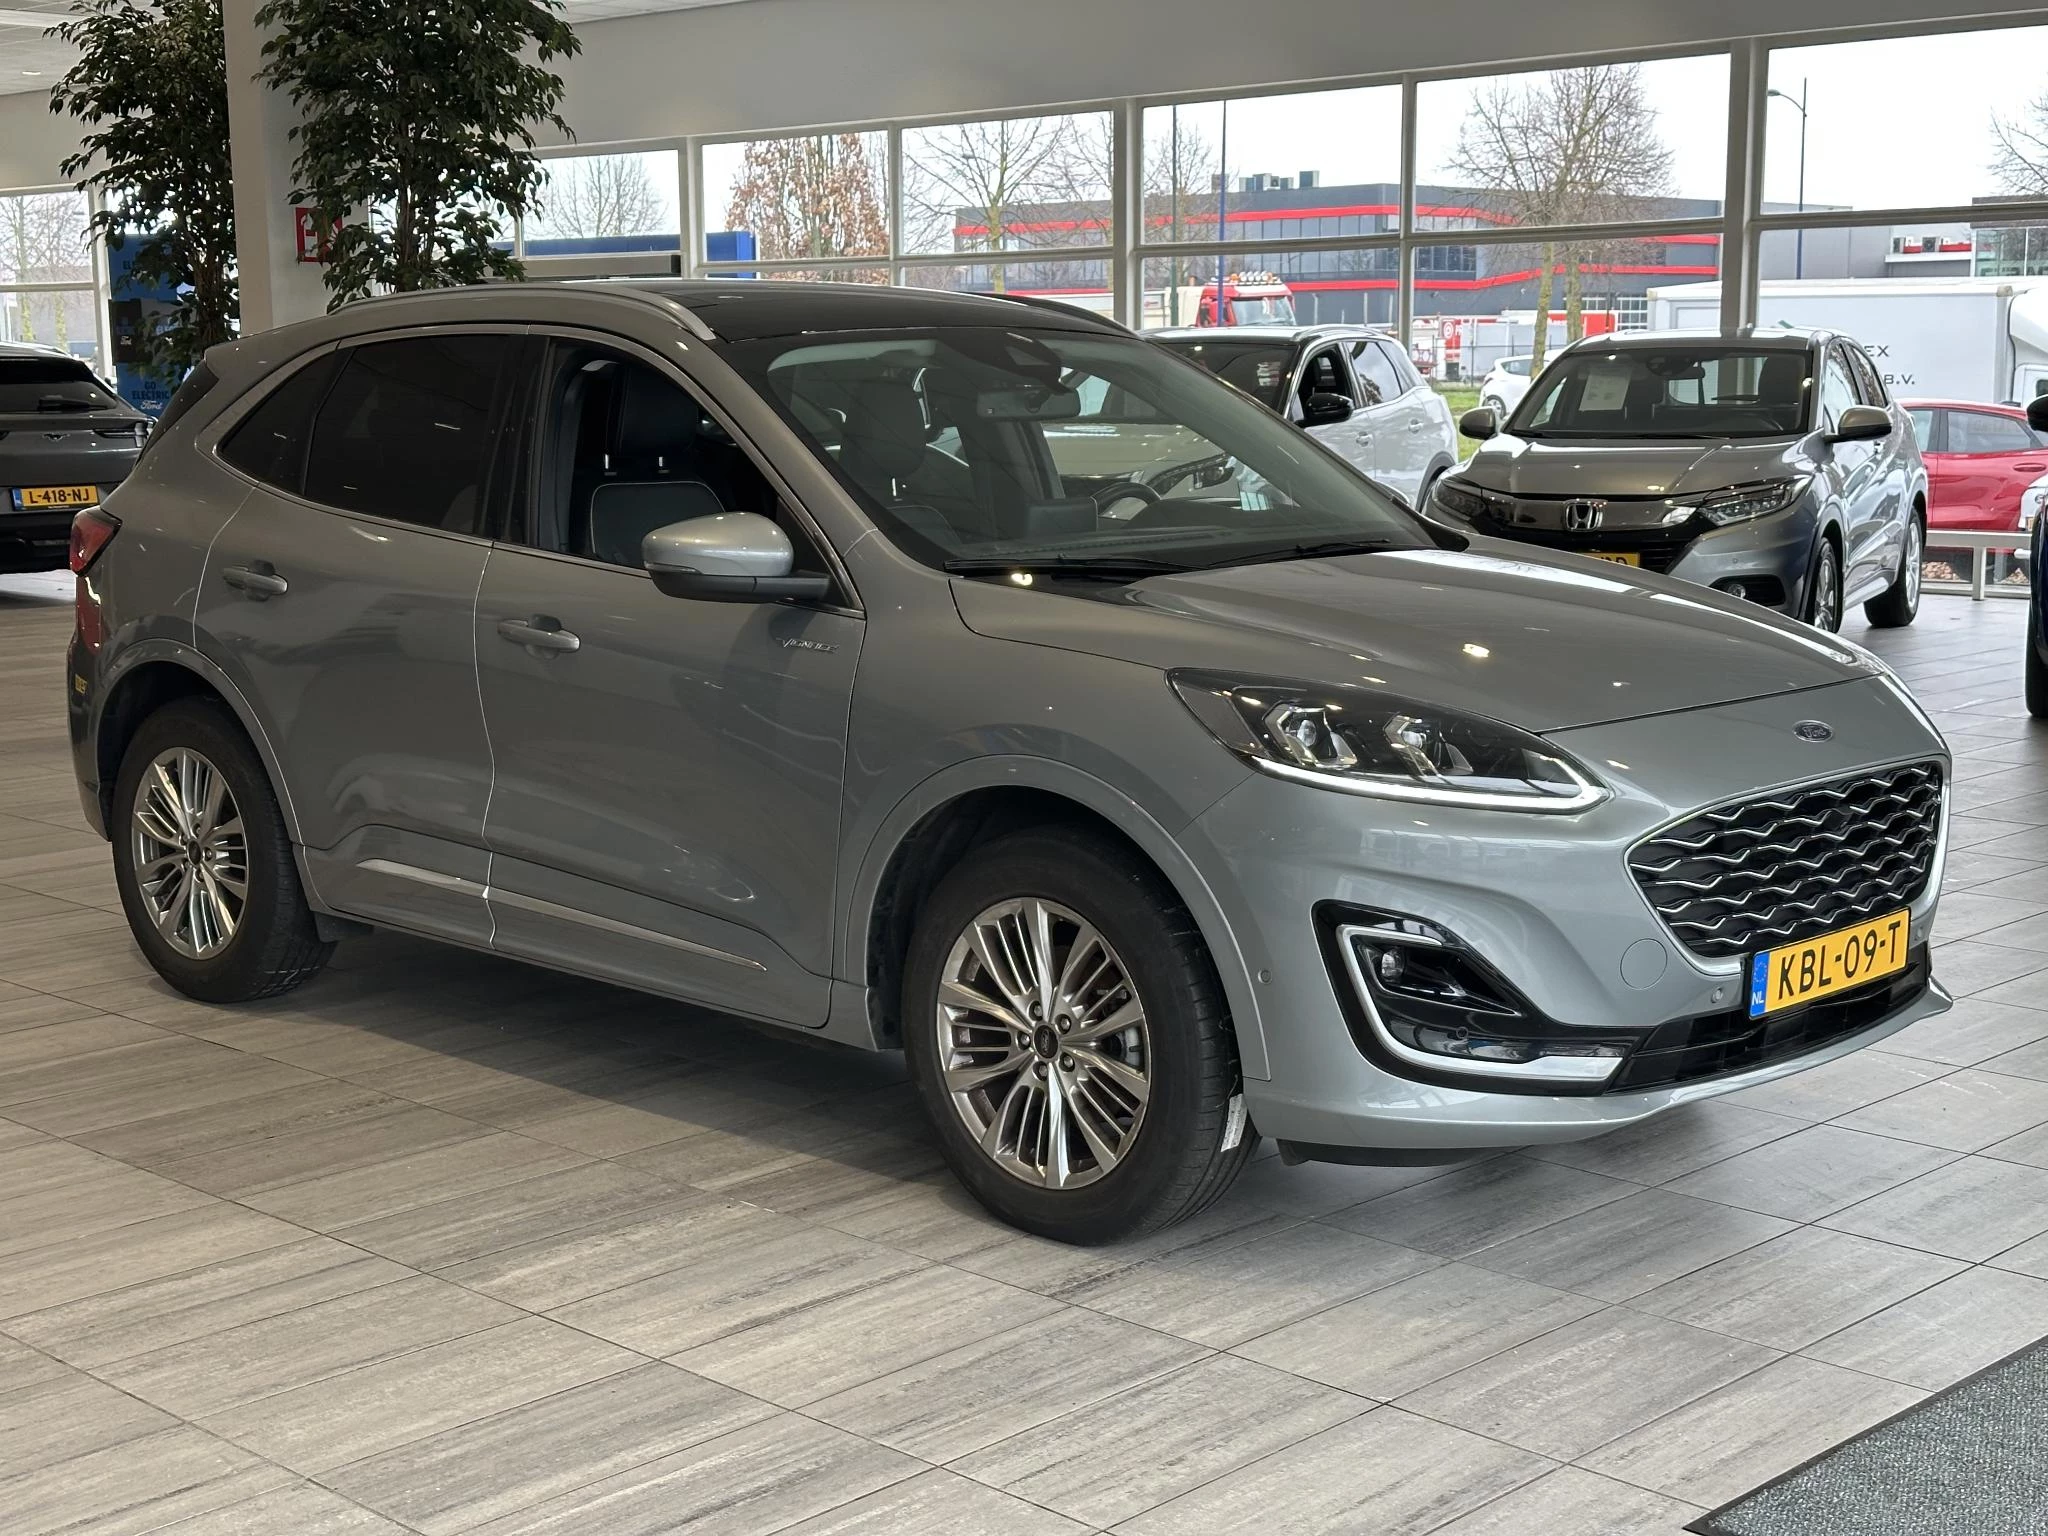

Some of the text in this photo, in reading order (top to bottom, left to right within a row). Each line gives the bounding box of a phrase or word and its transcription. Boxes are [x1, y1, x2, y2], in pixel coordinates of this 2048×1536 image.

[1884, 374, 1916, 385] B.V.
[144, 381, 157, 390] GO
[132, 390, 170, 400] ELECTRIC
[140, 400, 163, 410] Ford
[29, 488, 90, 504] L-418-NJ
[1778, 920, 1901, 1000] KBL-09-T
[1752, 991, 1765, 1006] NL
